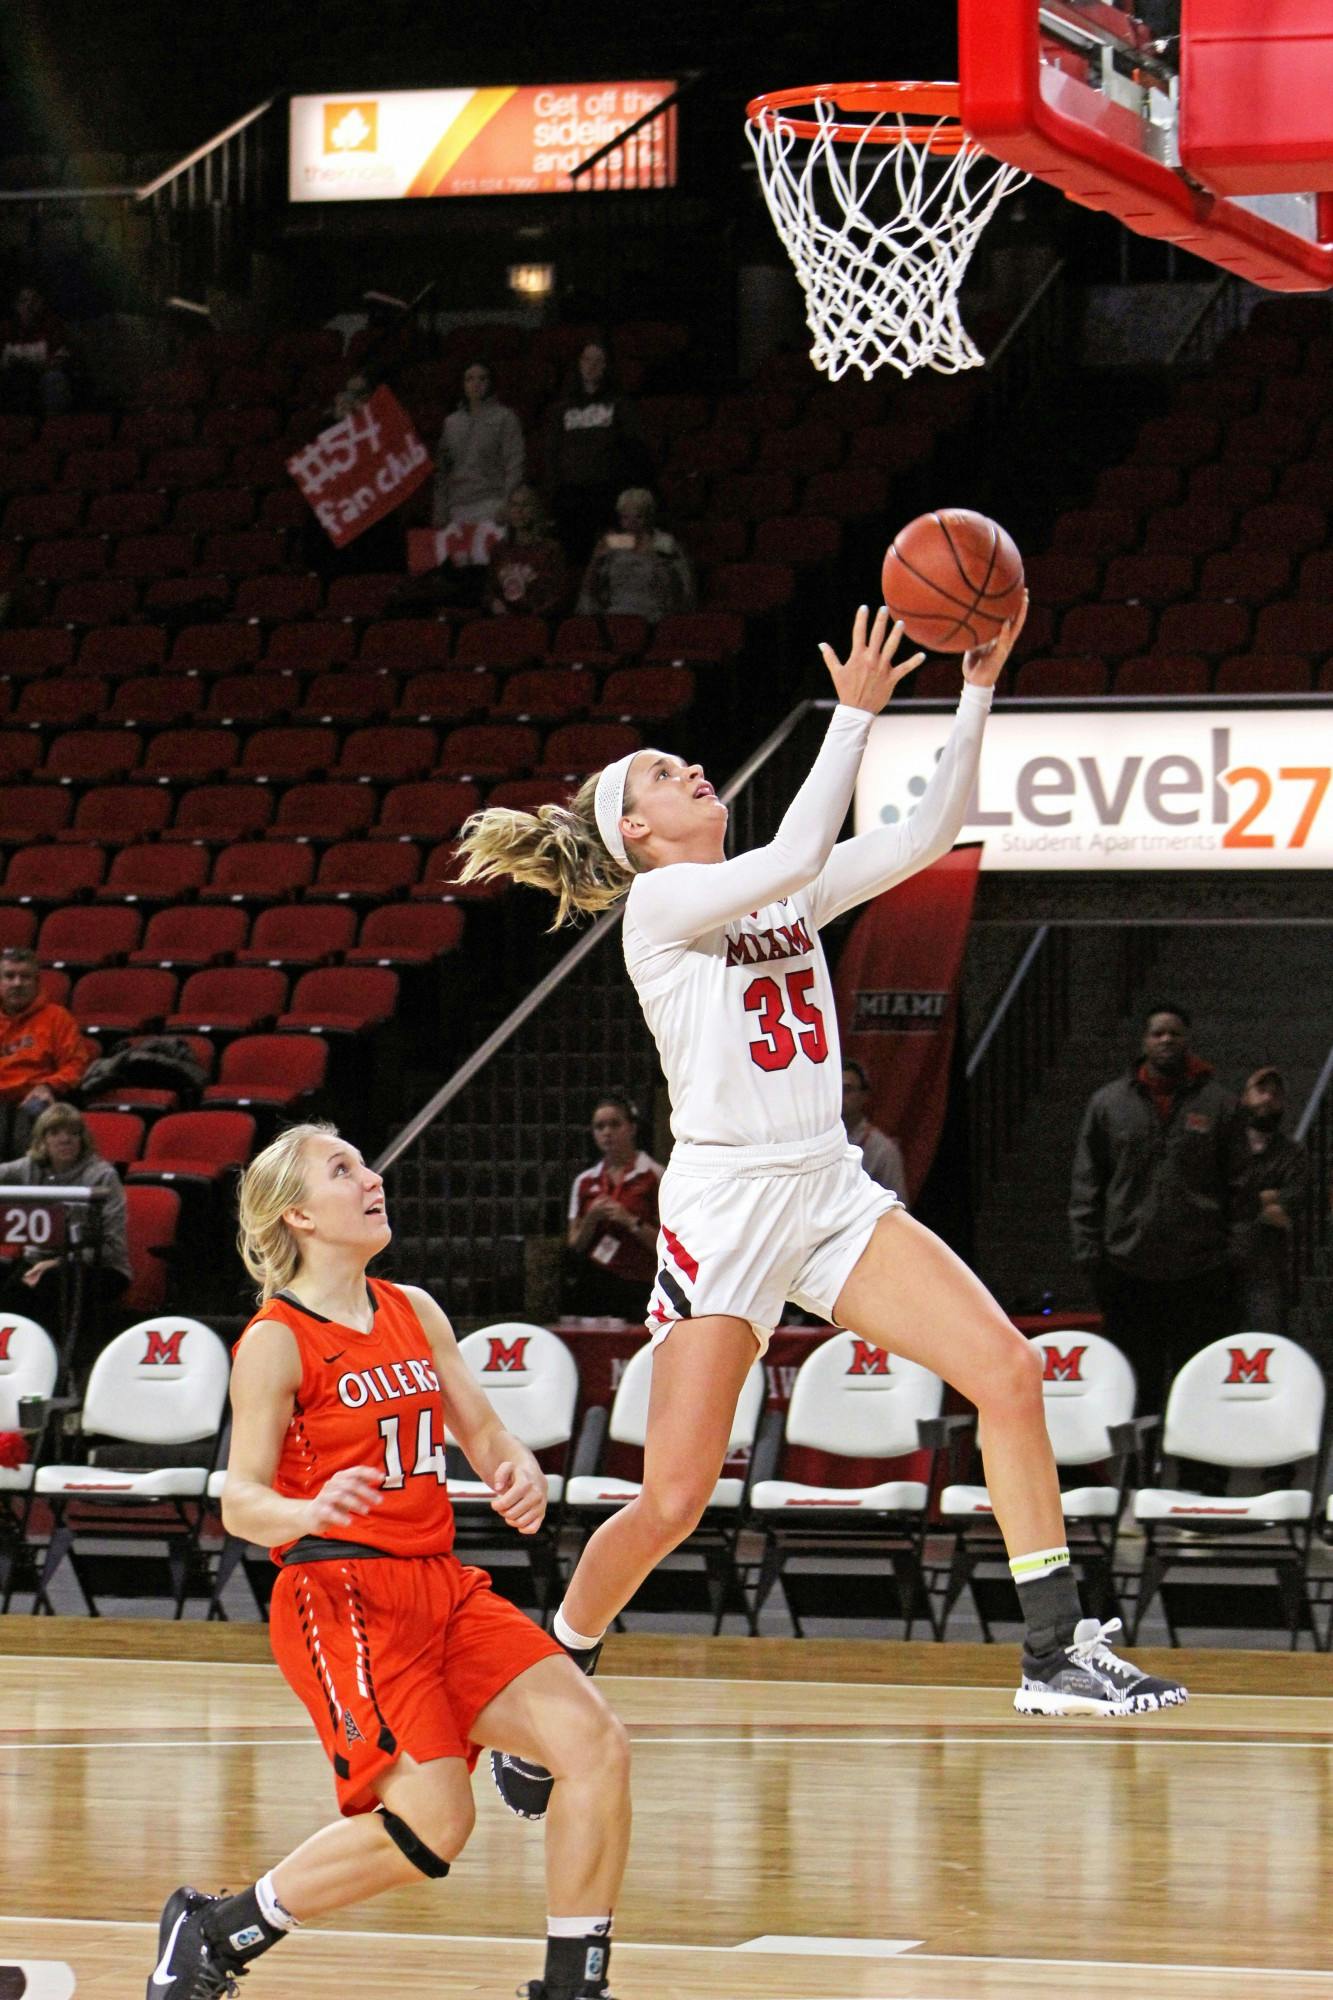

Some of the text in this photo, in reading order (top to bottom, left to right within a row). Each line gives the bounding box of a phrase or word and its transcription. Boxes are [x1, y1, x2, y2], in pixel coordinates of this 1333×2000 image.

[534, 86, 665, 118] Get off the
[533, 148, 579, 174] and
[287, 403, 382, 494] #54
[1221, 766, 1332, 849] 27
[1002, 832, 1216, 854] Student Apartments
[744, 967, 829, 1073] 35
[857, 994, 943, 1016] MIAMI
[4, 1208, 51, 1244] 20
[139, 1330, 189, 1365] M
[482, 1336, 532, 1373] M
[845, 1339, 890, 1376] M
[1043, 1345, 1088, 1382] M
[1222, 1347, 1277, 1385] M
[337, 1358, 441, 1409] OILERS
[378, 1408, 447, 1491] 14
